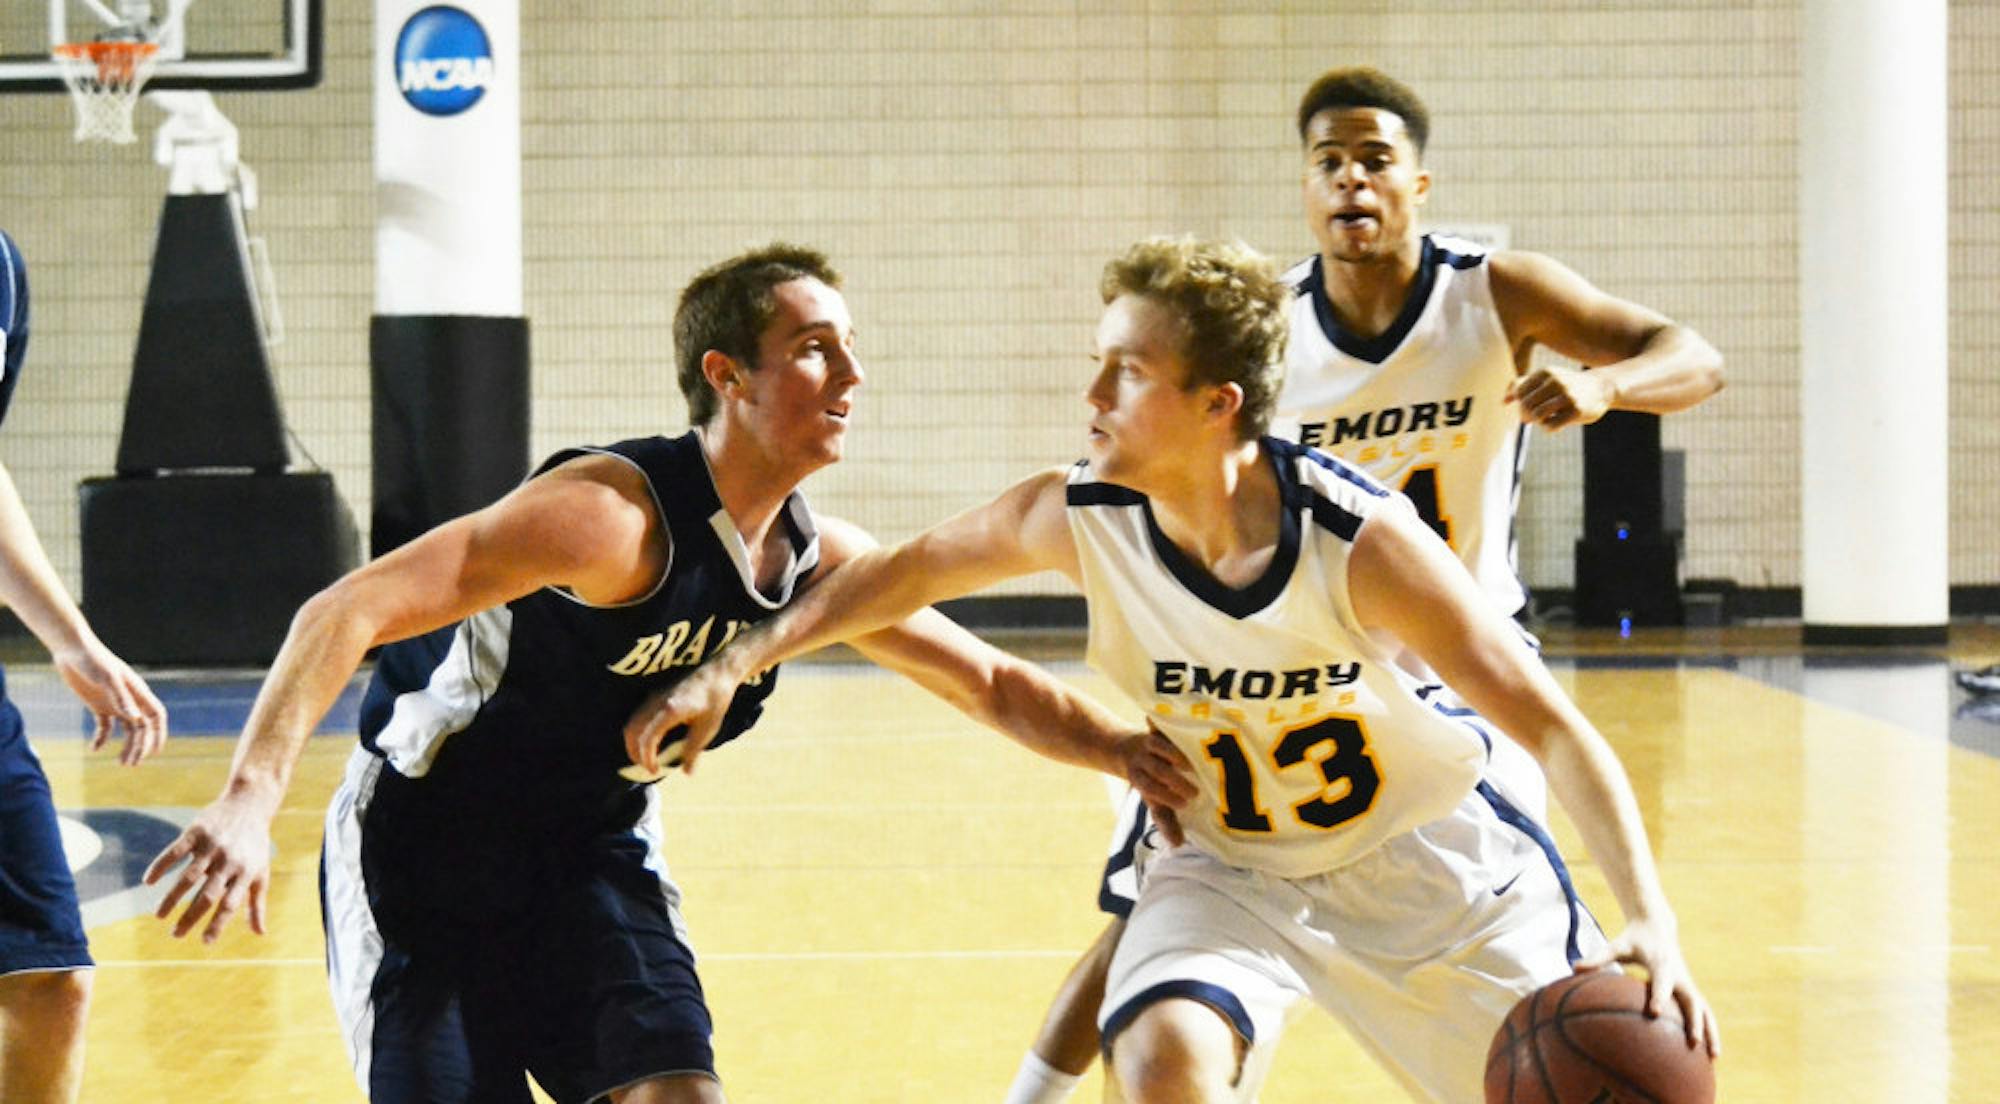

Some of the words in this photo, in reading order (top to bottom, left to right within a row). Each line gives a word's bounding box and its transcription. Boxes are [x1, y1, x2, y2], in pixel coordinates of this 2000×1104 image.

[402, 57, 494, 93] NCAA
[1299, 395, 1474, 447] EMORY
[1154, 660, 1362, 700] EMORY
[1202, 711, 1387, 832] 13
